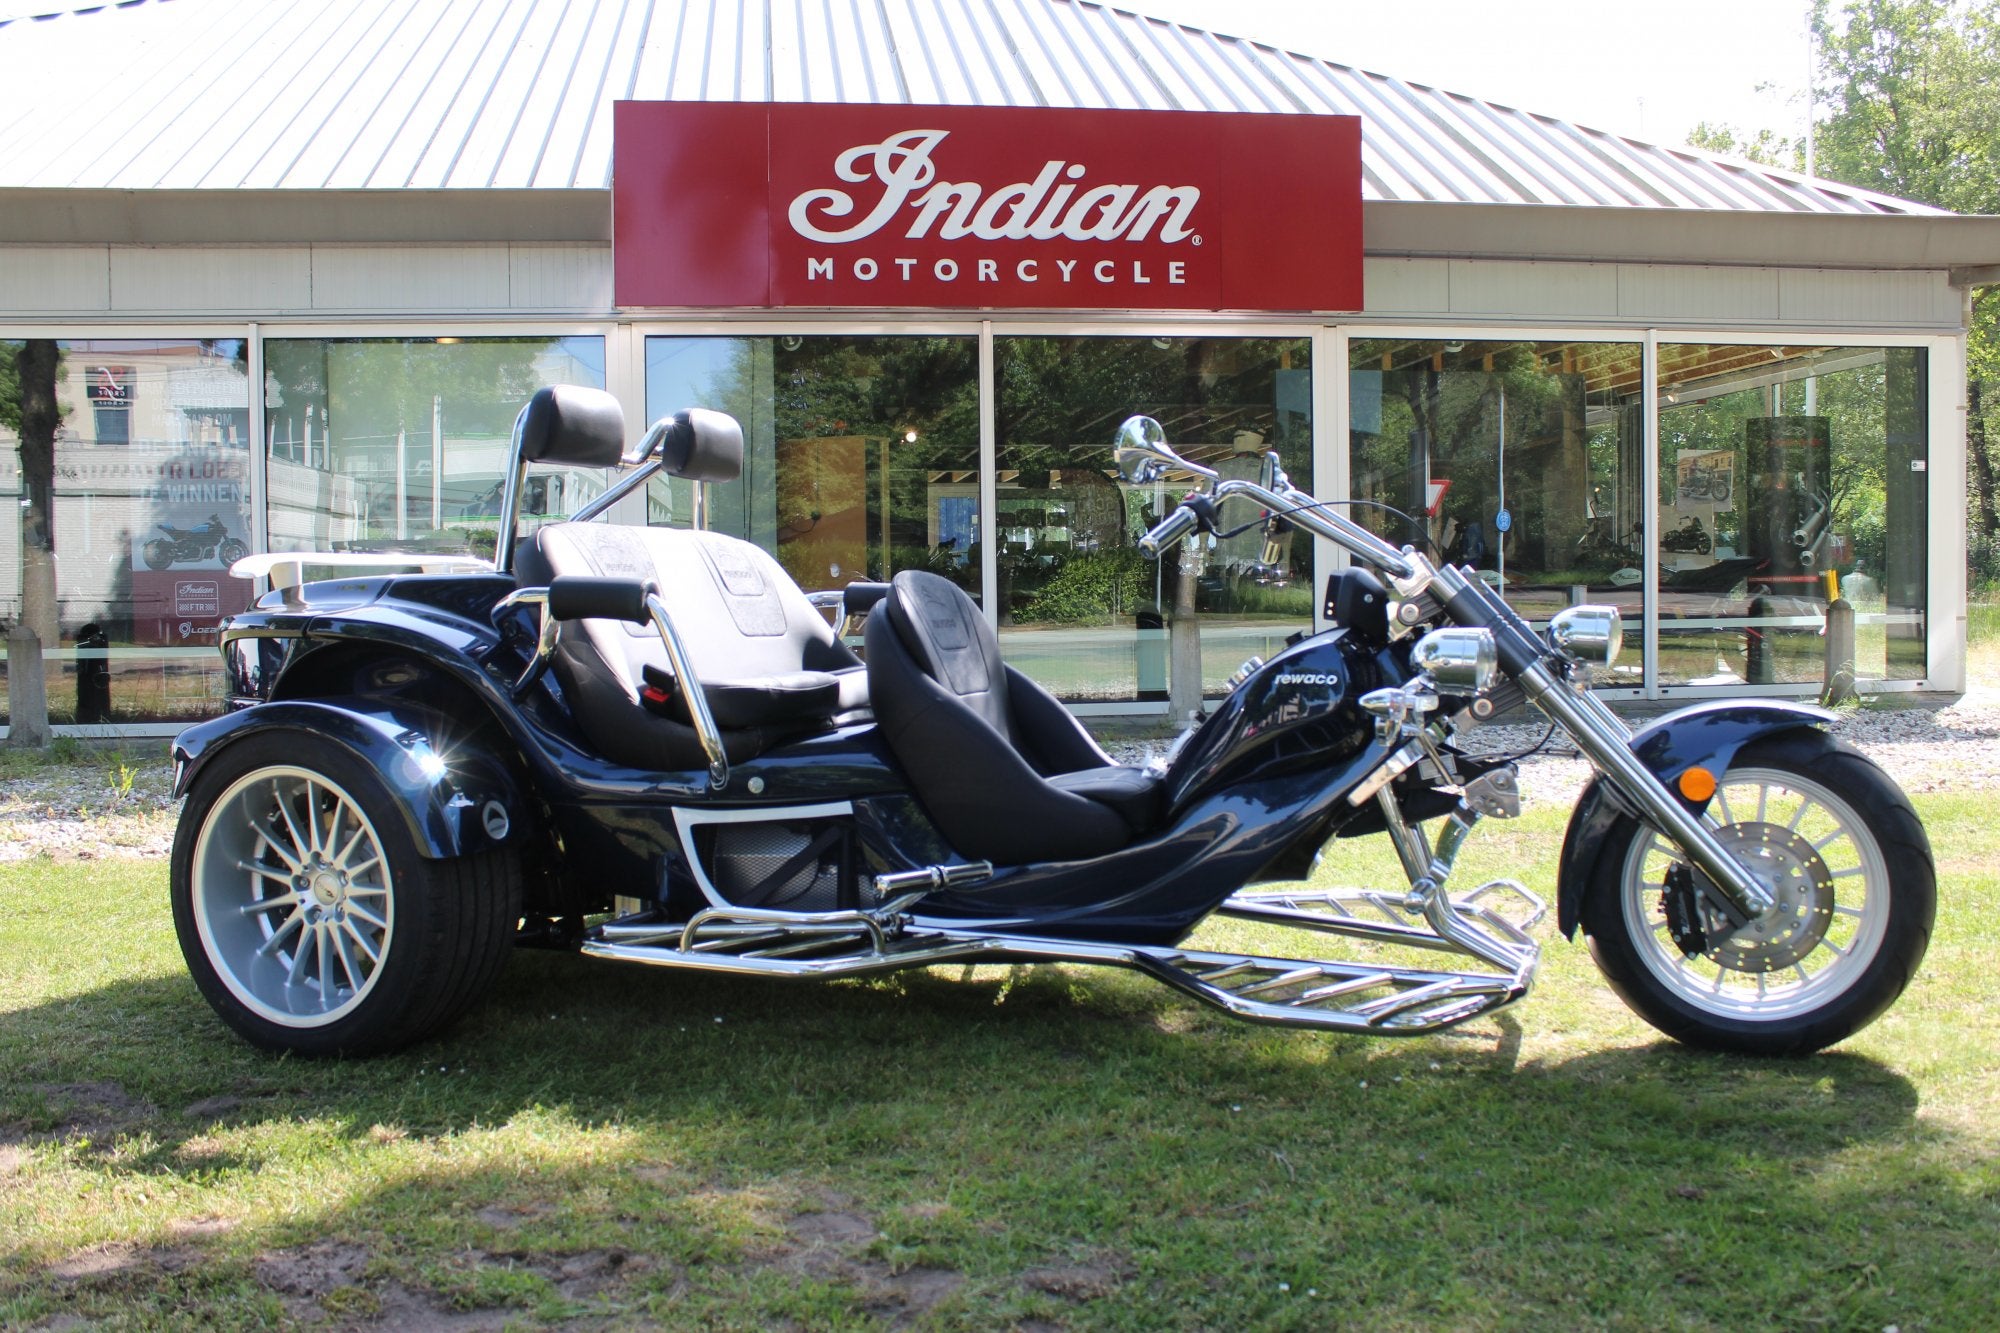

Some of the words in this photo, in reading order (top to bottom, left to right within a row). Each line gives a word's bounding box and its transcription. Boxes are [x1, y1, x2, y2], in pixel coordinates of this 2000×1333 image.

[787, 129, 1201, 243] Indian
[807, 257, 1186, 284] MOTORCYCLE
[166, 484, 243, 502] WINNEN
[1274, 674, 1338, 685] rewaco
